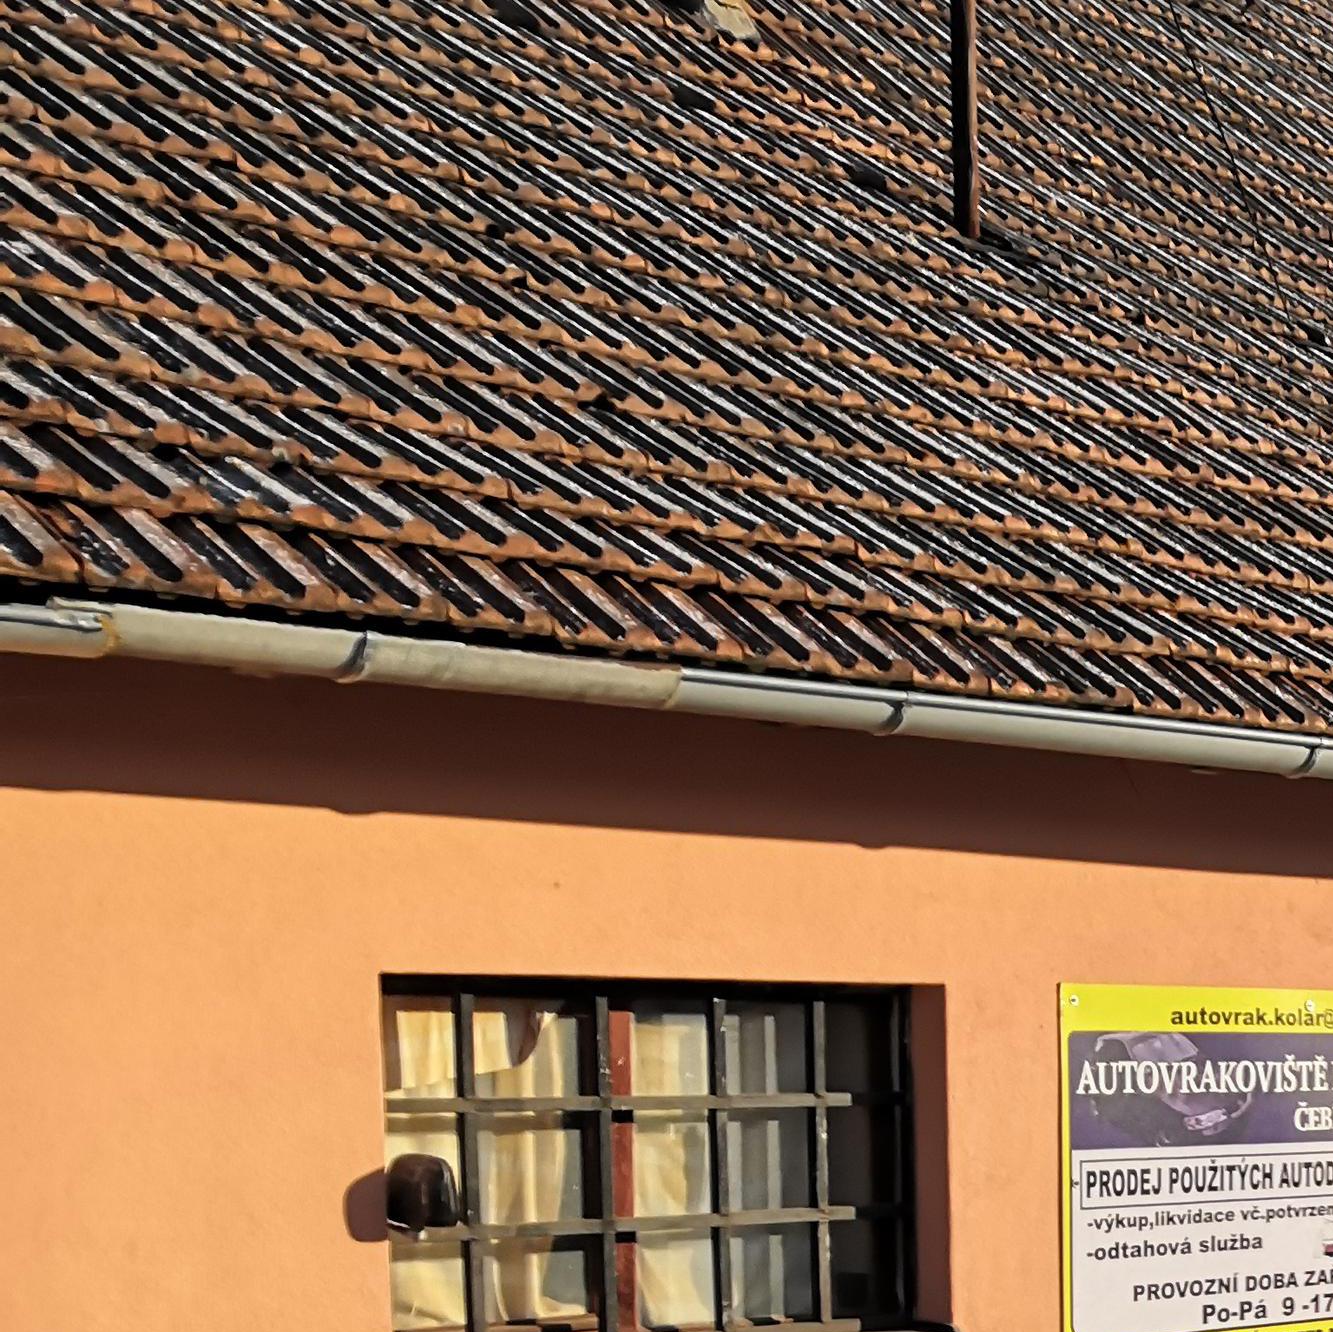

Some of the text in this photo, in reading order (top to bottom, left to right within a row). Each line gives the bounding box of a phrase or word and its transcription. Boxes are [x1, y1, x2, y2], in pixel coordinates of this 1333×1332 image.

[1076, 1054, 1329, 1094] AUTOVRAKOVIŠTĚ
[1086, 1167, 1162, 1198] PRODEJ
[1168, 1157, 1274, 1194] POUŽITÝCH
[1087, 1208, 1236, 1233] -výkup,likvidace
[1086, 1232, 1263, 1261] -odtahová služba
[1133, 1272, 1239, 1302] PROVOZNÍ
[1245, 1272, 1299, 1293] DOBA
[1202, 1299, 1268, 1324] Po-Pá
[1282, 1296, 1295, 1316] 9
